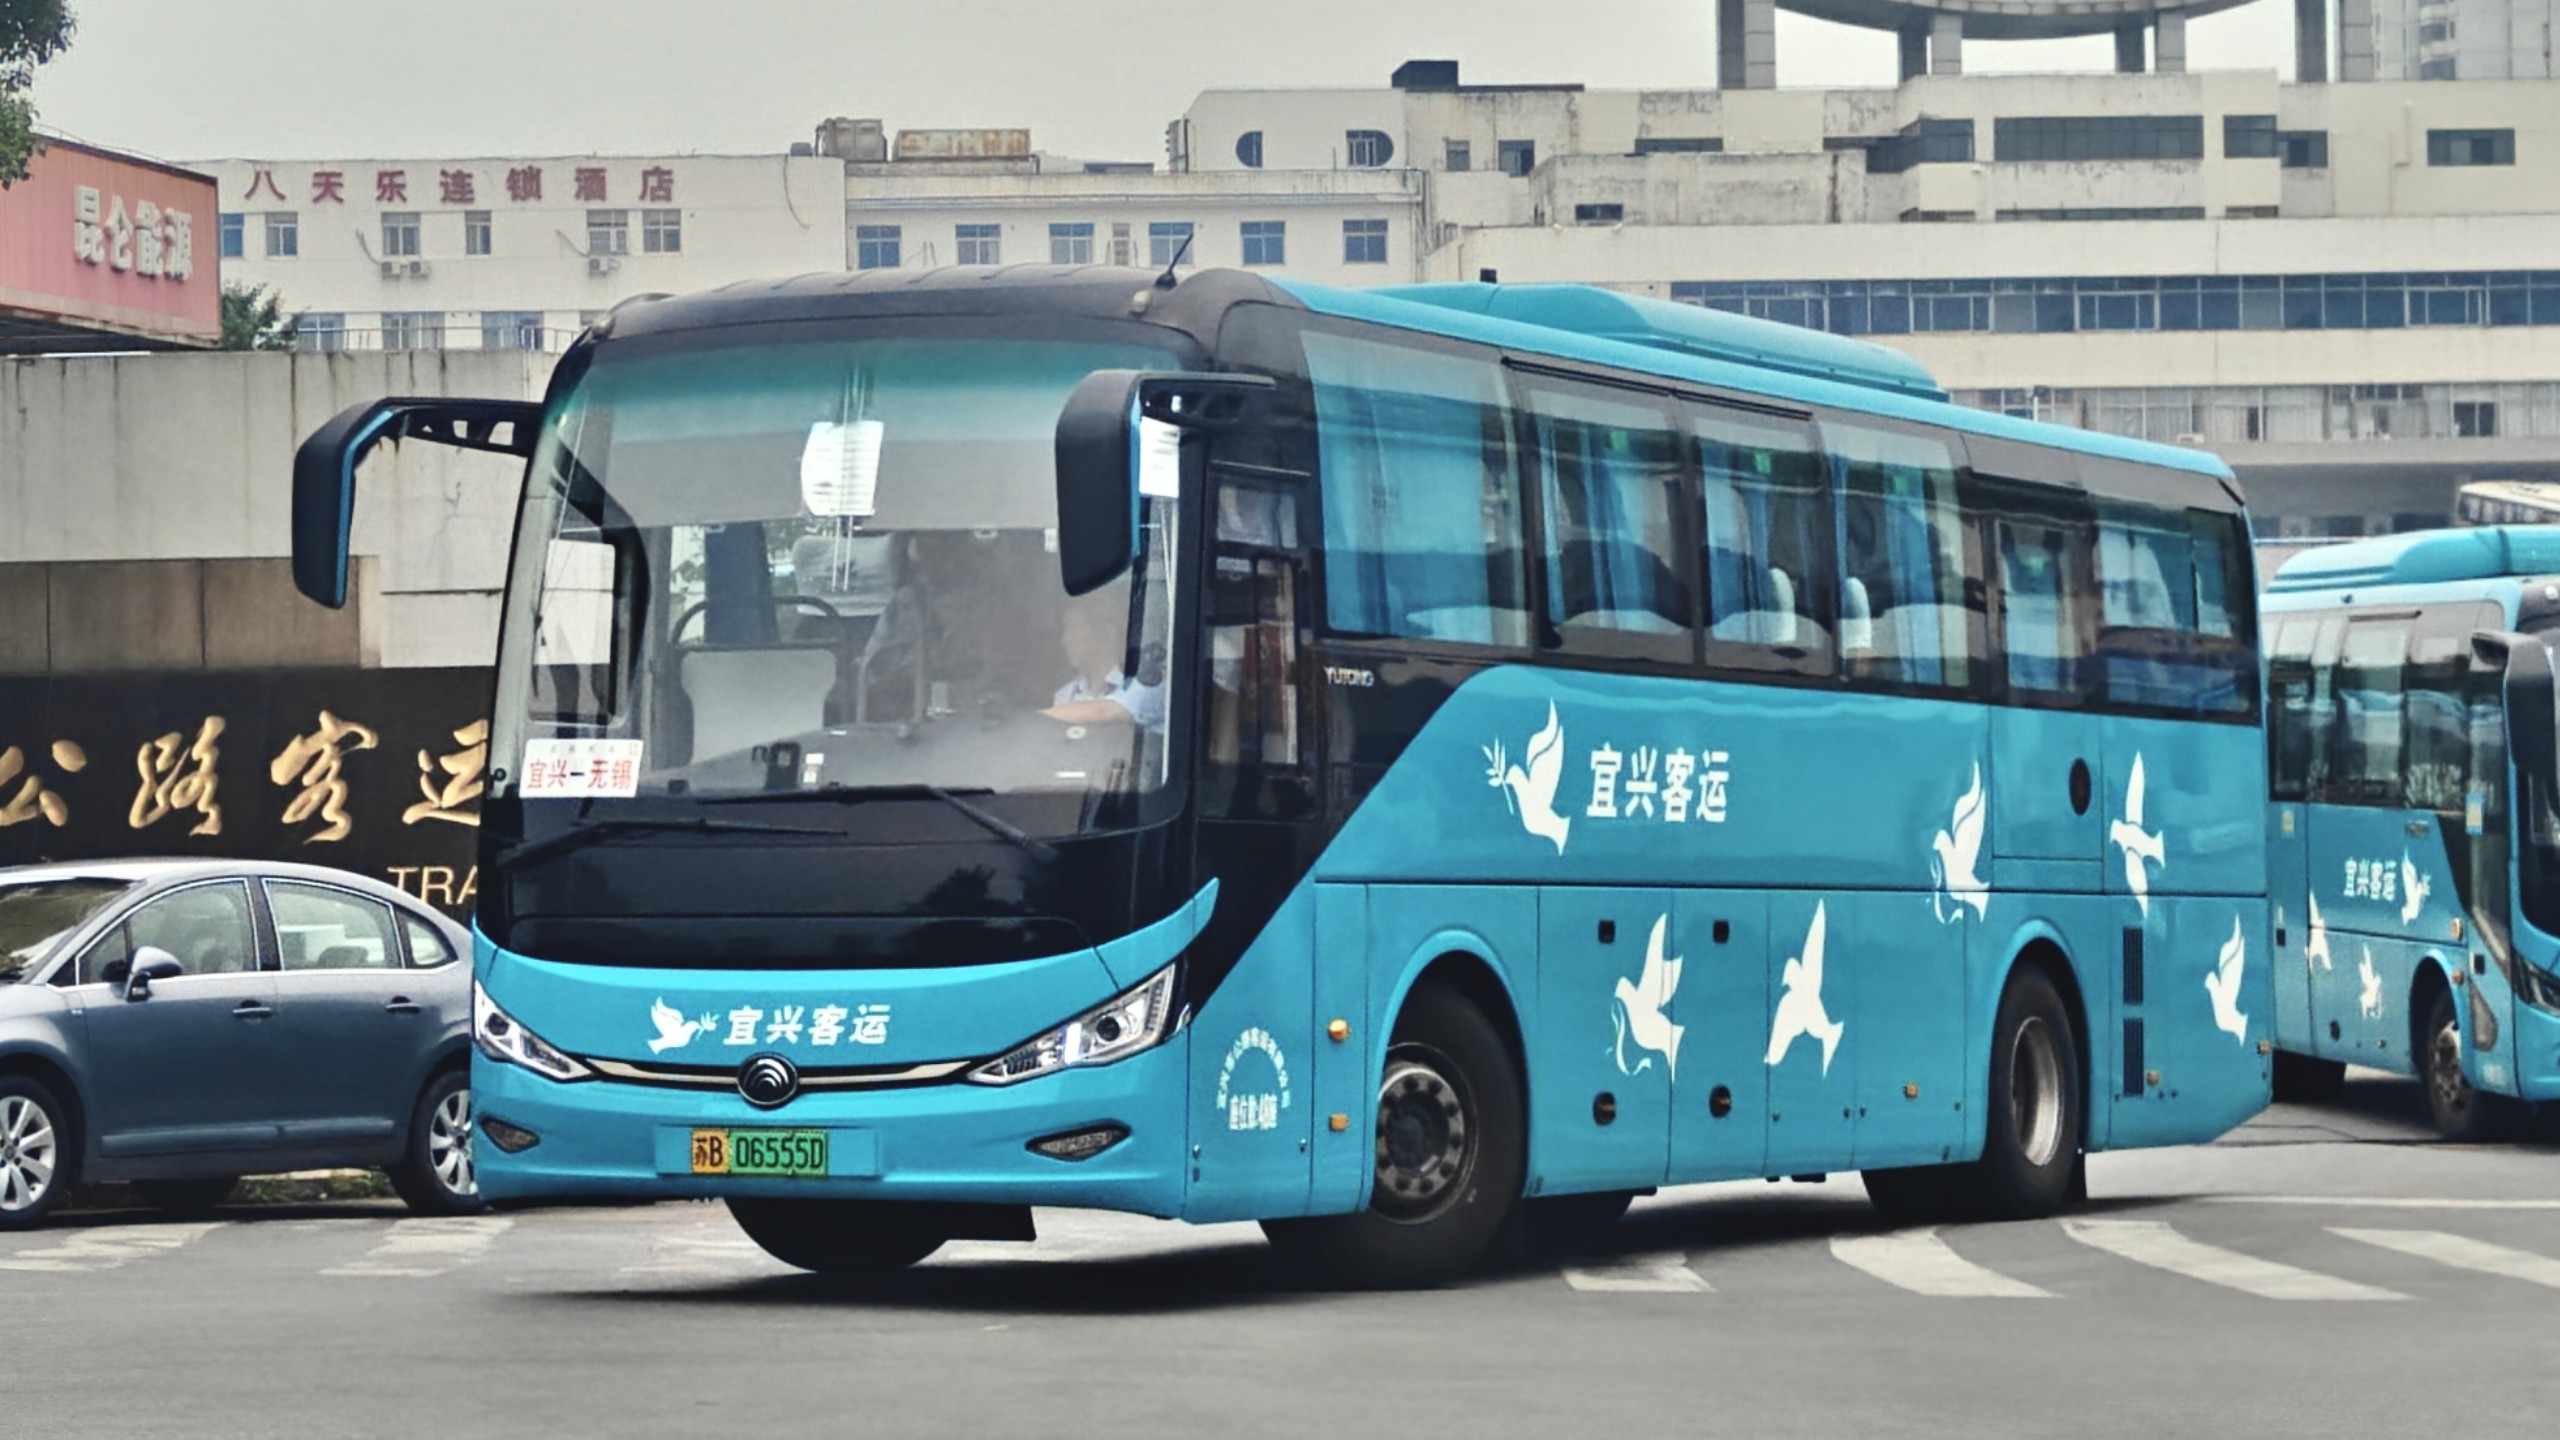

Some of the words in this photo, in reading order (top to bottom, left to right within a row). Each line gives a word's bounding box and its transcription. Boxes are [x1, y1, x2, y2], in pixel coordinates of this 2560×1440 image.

[243, 165, 675, 204] 八天乐连锁酒店
[74, 184, 193, 281] 昆仑能源
[1586, 744, 1730, 823] 宜兴客运
[722, 1003, 891, 1046] 宜兴客运
